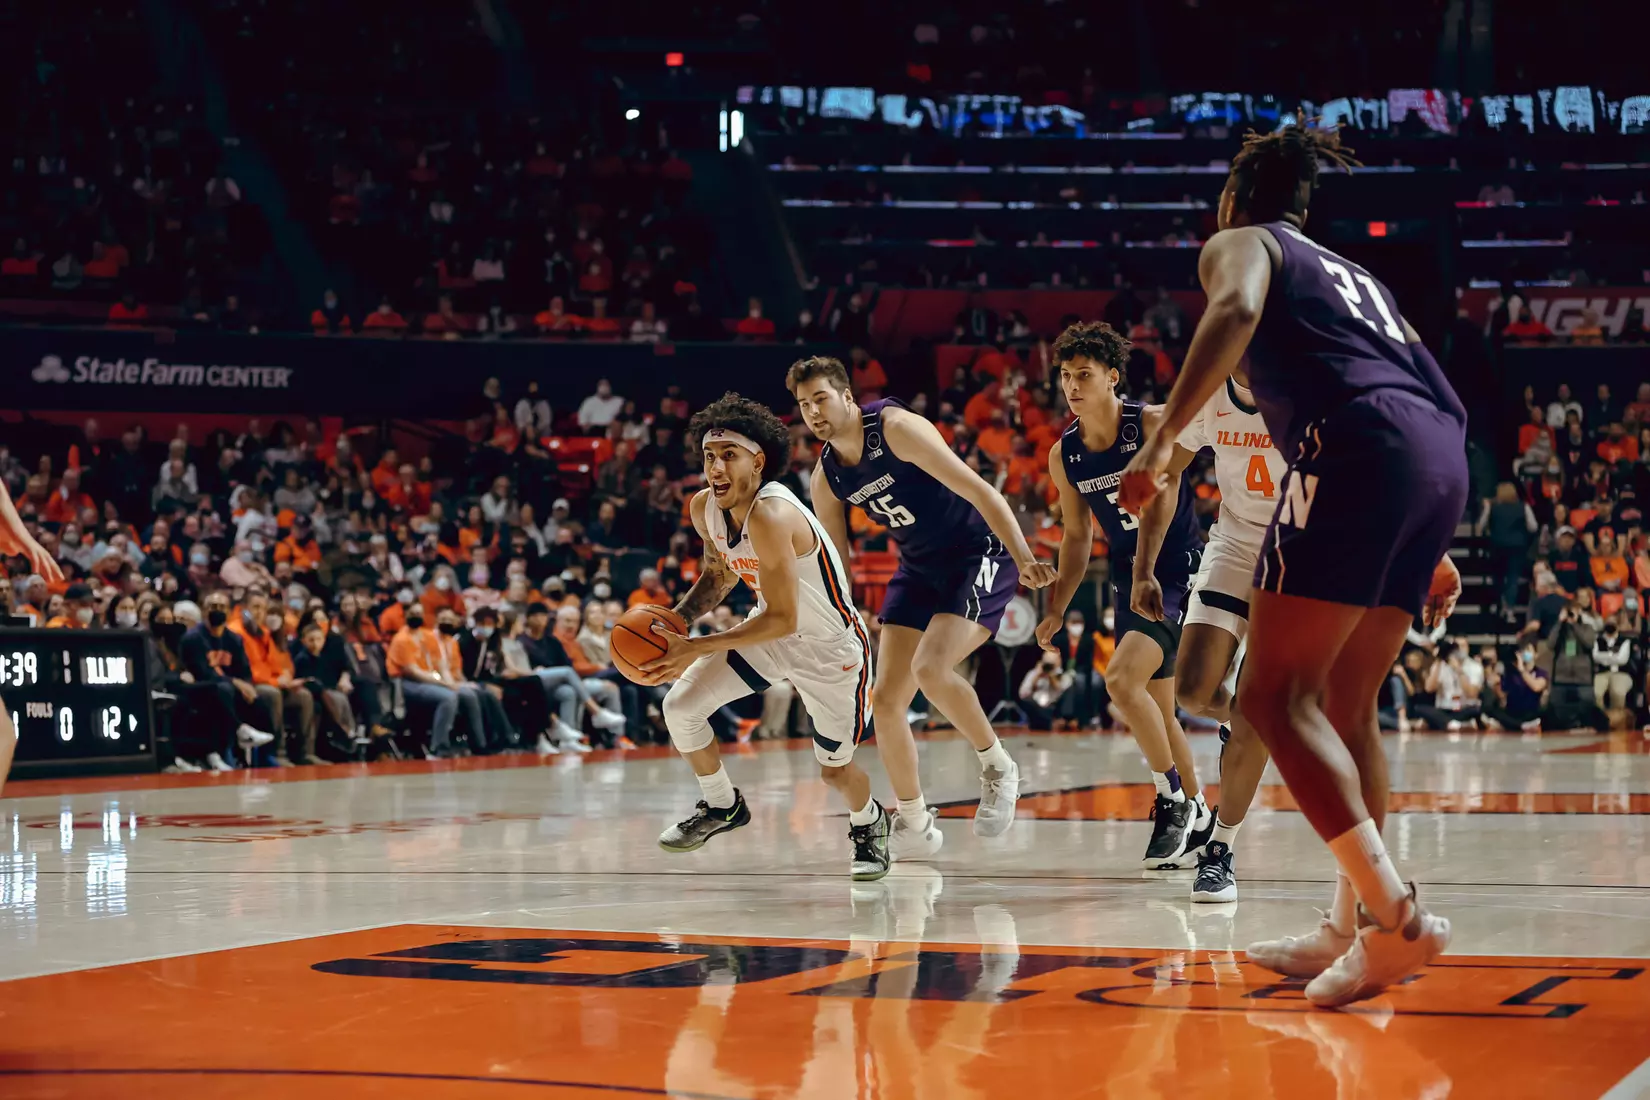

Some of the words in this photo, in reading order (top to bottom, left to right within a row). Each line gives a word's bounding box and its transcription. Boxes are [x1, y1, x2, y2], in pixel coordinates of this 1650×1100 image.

[1318, 255, 1406, 345] 21
[206, 365, 292, 387] CENTER
[1216, 430, 1273, 449] ILLINO
[1076, 471, 1123, 493] NORTHWES
[1245, 454, 1275, 498] 4
[868, 493, 916, 528] 15
[1279, 470, 1319, 530] N
[974, 555, 1000, 594] N
[26, 702, 53, 718] FOULS
[59, 706, 74, 741] 0
[102, 705, 121, 740] 12
